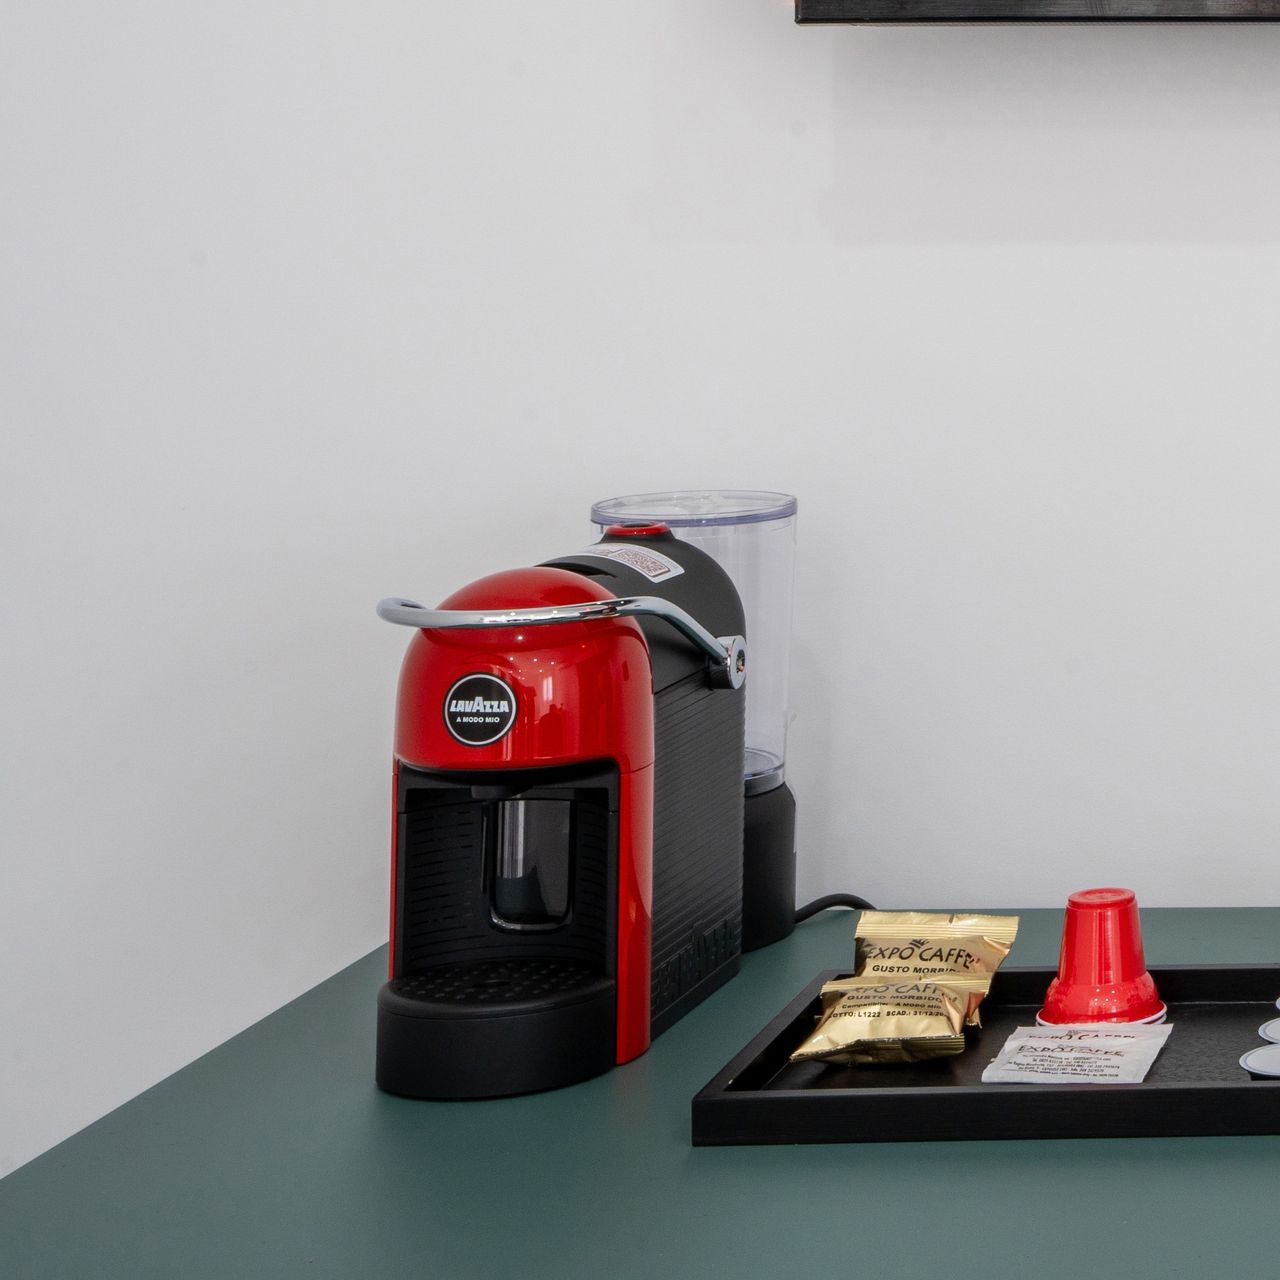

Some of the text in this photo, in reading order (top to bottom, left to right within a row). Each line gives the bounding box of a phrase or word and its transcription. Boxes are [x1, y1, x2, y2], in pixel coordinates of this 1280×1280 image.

[449, 696, 510, 713] LAVAZZA
[867, 946, 915, 961] EXPO
[872, 964, 910, 973] GUSTO
